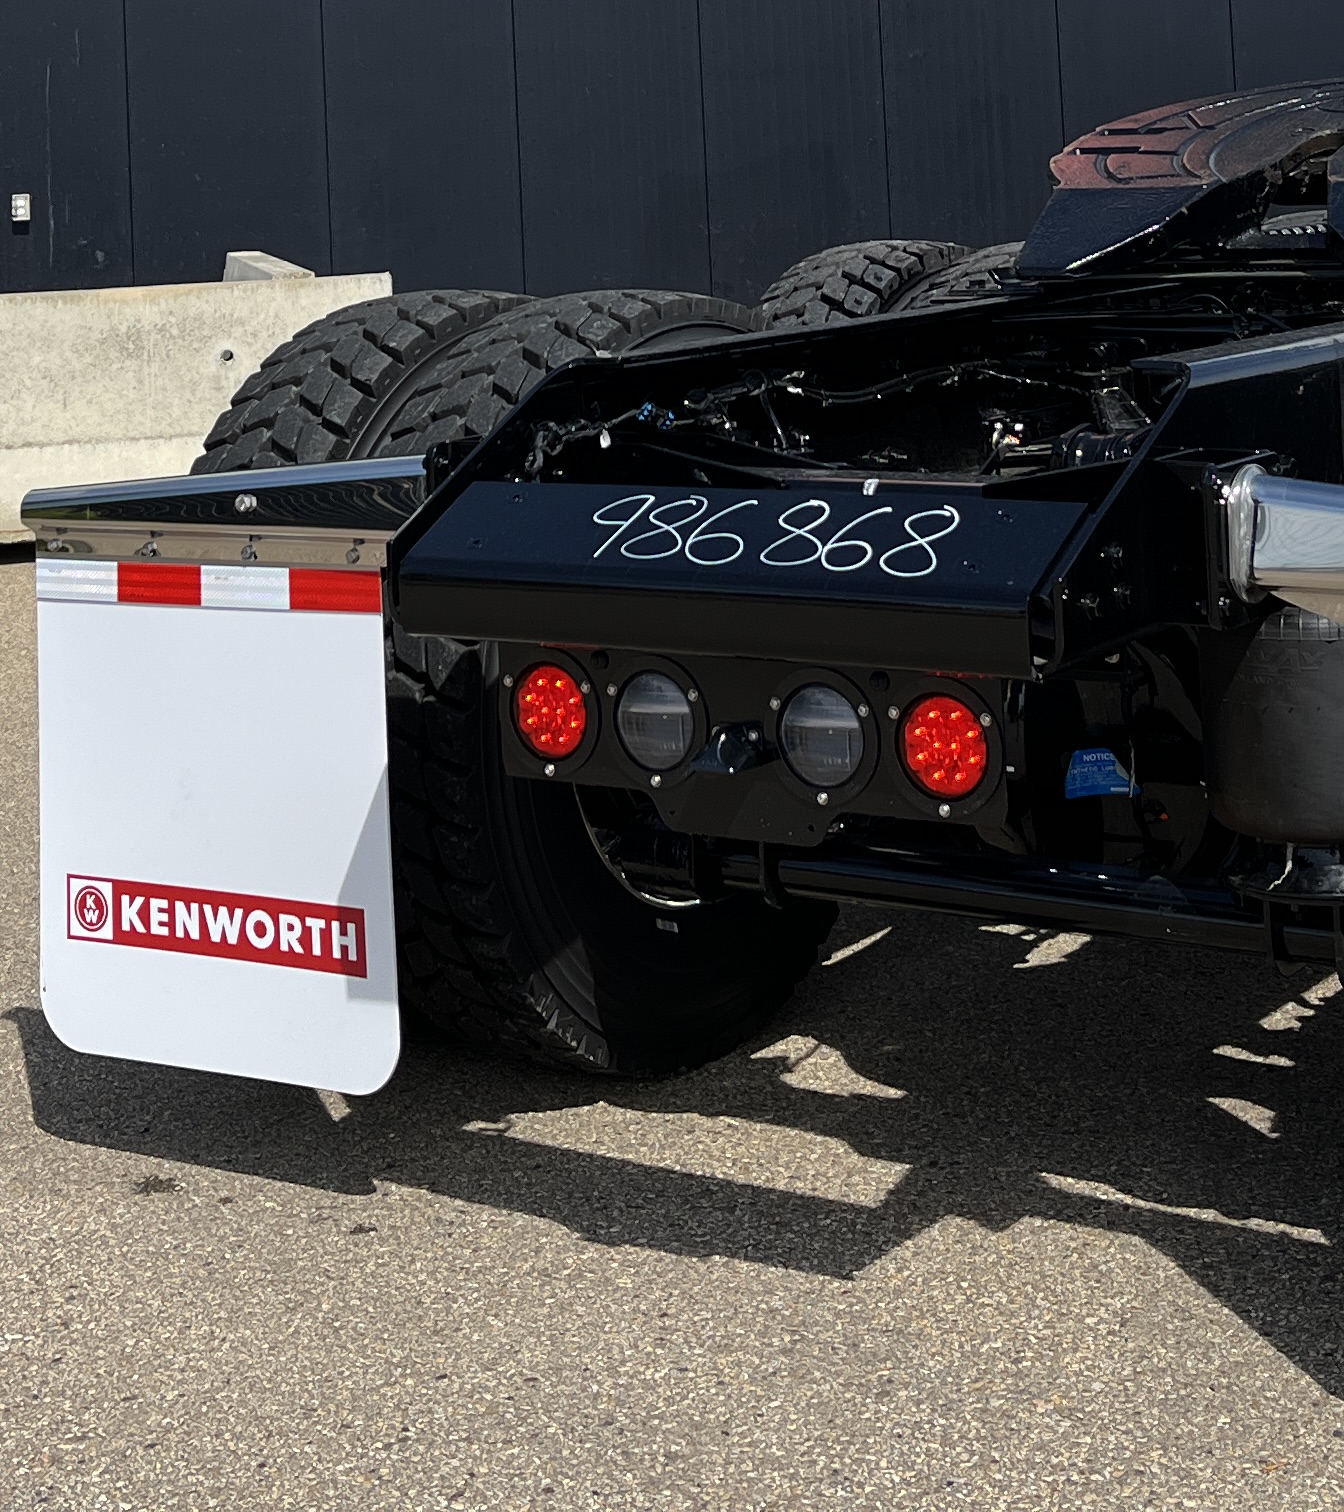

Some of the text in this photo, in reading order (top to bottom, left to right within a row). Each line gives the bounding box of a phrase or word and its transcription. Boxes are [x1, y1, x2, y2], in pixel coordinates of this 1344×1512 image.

[84, 894, 96, 909] K
[83, 908, 99, 925] W
[120, 894, 358, 962] KENWORTH
